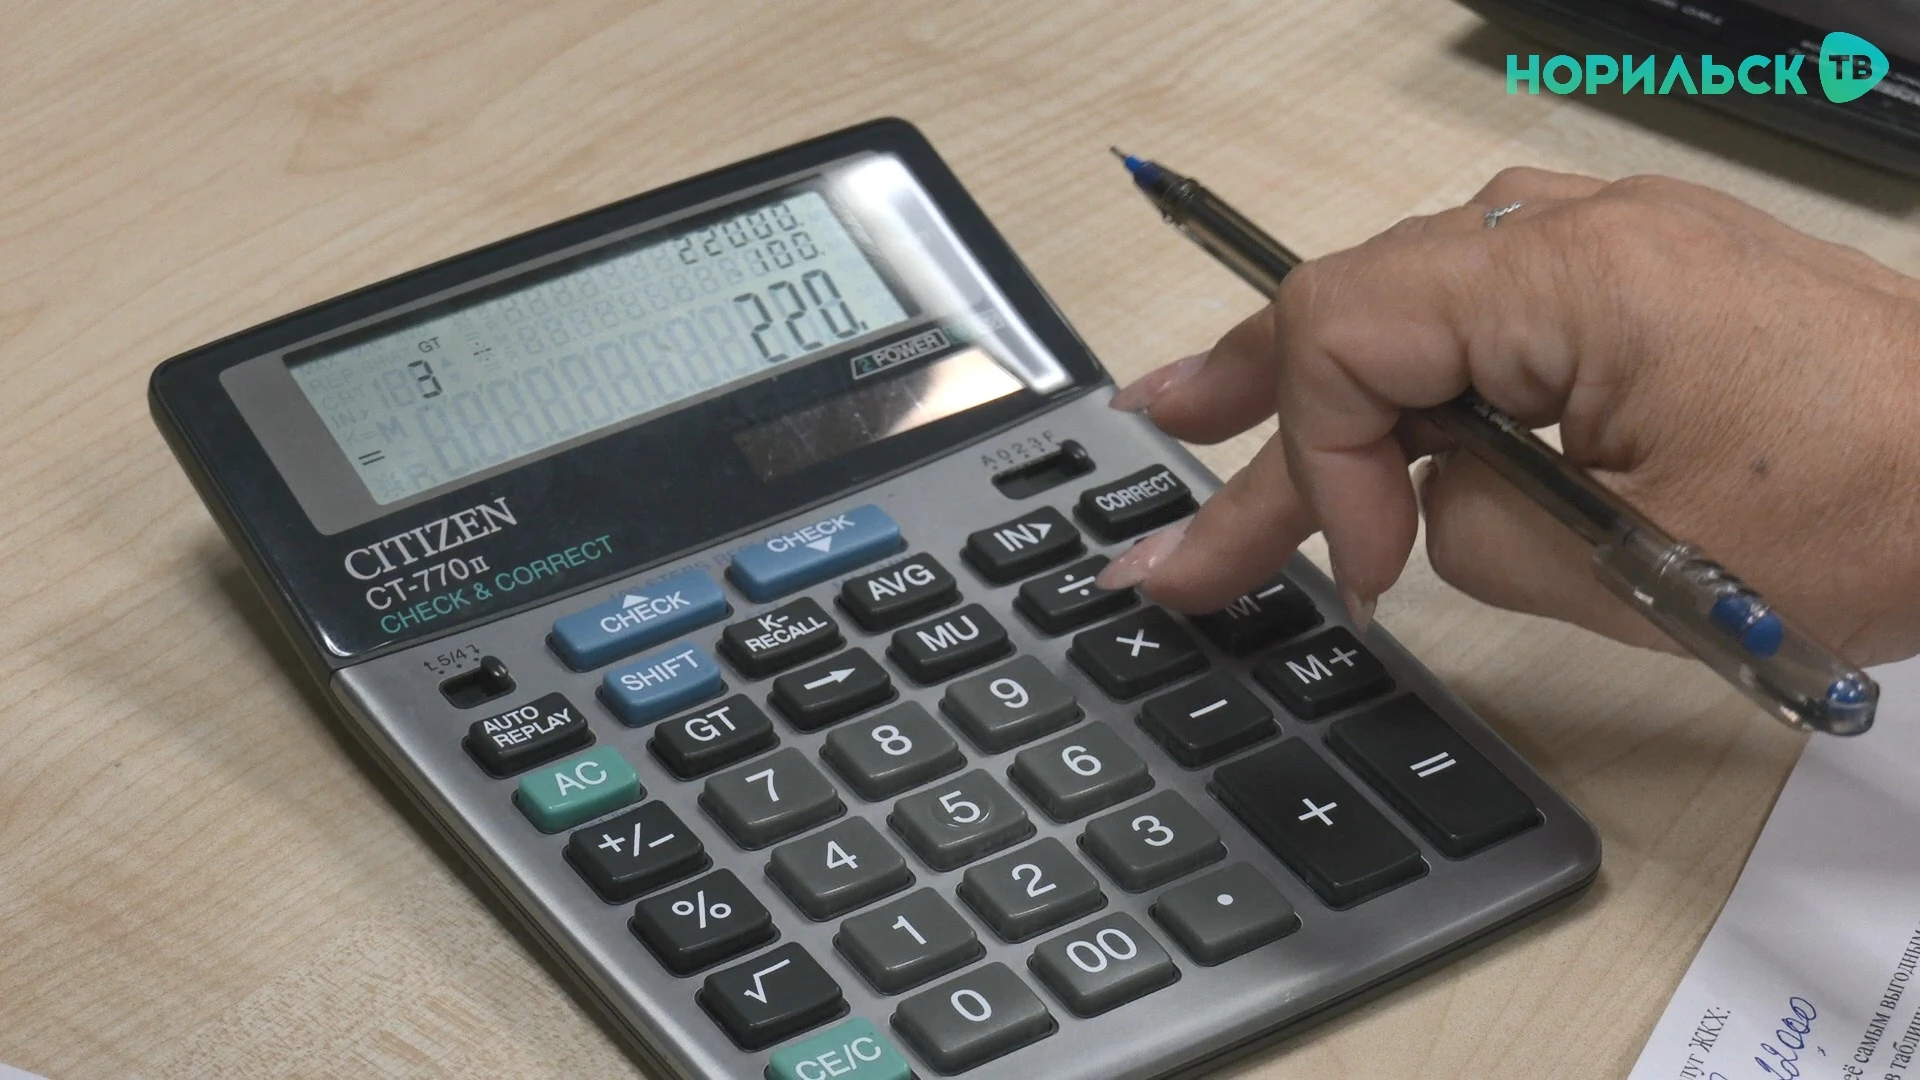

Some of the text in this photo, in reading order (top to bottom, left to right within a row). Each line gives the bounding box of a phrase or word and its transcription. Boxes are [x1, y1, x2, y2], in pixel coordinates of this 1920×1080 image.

[418, 336, 441, 353] GT
[871, 332, 942, 367] POWER
[408, 359, 443, 399] 3
[1095, 470, 1178, 512] CORRECT
[344, 497, 519, 580] CITIZEN
[766, 514, 856, 553] CHECK
[381, 589, 472, 634] CHECK
[473, 582, 494, 600] &
[495, 534, 614, 592] CORRECT
[867, 564, 936, 601] AVG
[600, 591, 691, 634] CHECK
[745, 616, 828, 652] RECALL
[916, 615, 981, 652] MU
[620, 649, 703, 692] SHIFT
[1285, 647, 1358, 685] M+
[989, 678, 1030, 709] 9
[483, 705, 539, 734] AUTO
[493, 708, 574, 748] REPLAY
[684, 706, 739, 742] GT
[871, 724, 913, 756] 8
[554, 761, 608, 796] AC
[1061, 745, 1102, 777] 6
[745, 768, 780, 802] 7
[938, 790, 981, 824] 5
[1131, 815, 1174, 847] 3
[825, 840, 859, 871] 4
[1011, 863, 1057, 898] 2
[671, 890, 732, 929] %
[892, 915, 927, 945] 1
[1065, 928, 1138, 973] 00
[950, 989, 992, 1022] 0
[1688, 1006, 1732, 1053] ЖКХ:
[1854, 1012, 1891, 1064] самым
[795, 1037, 882, 1080] CE/C
